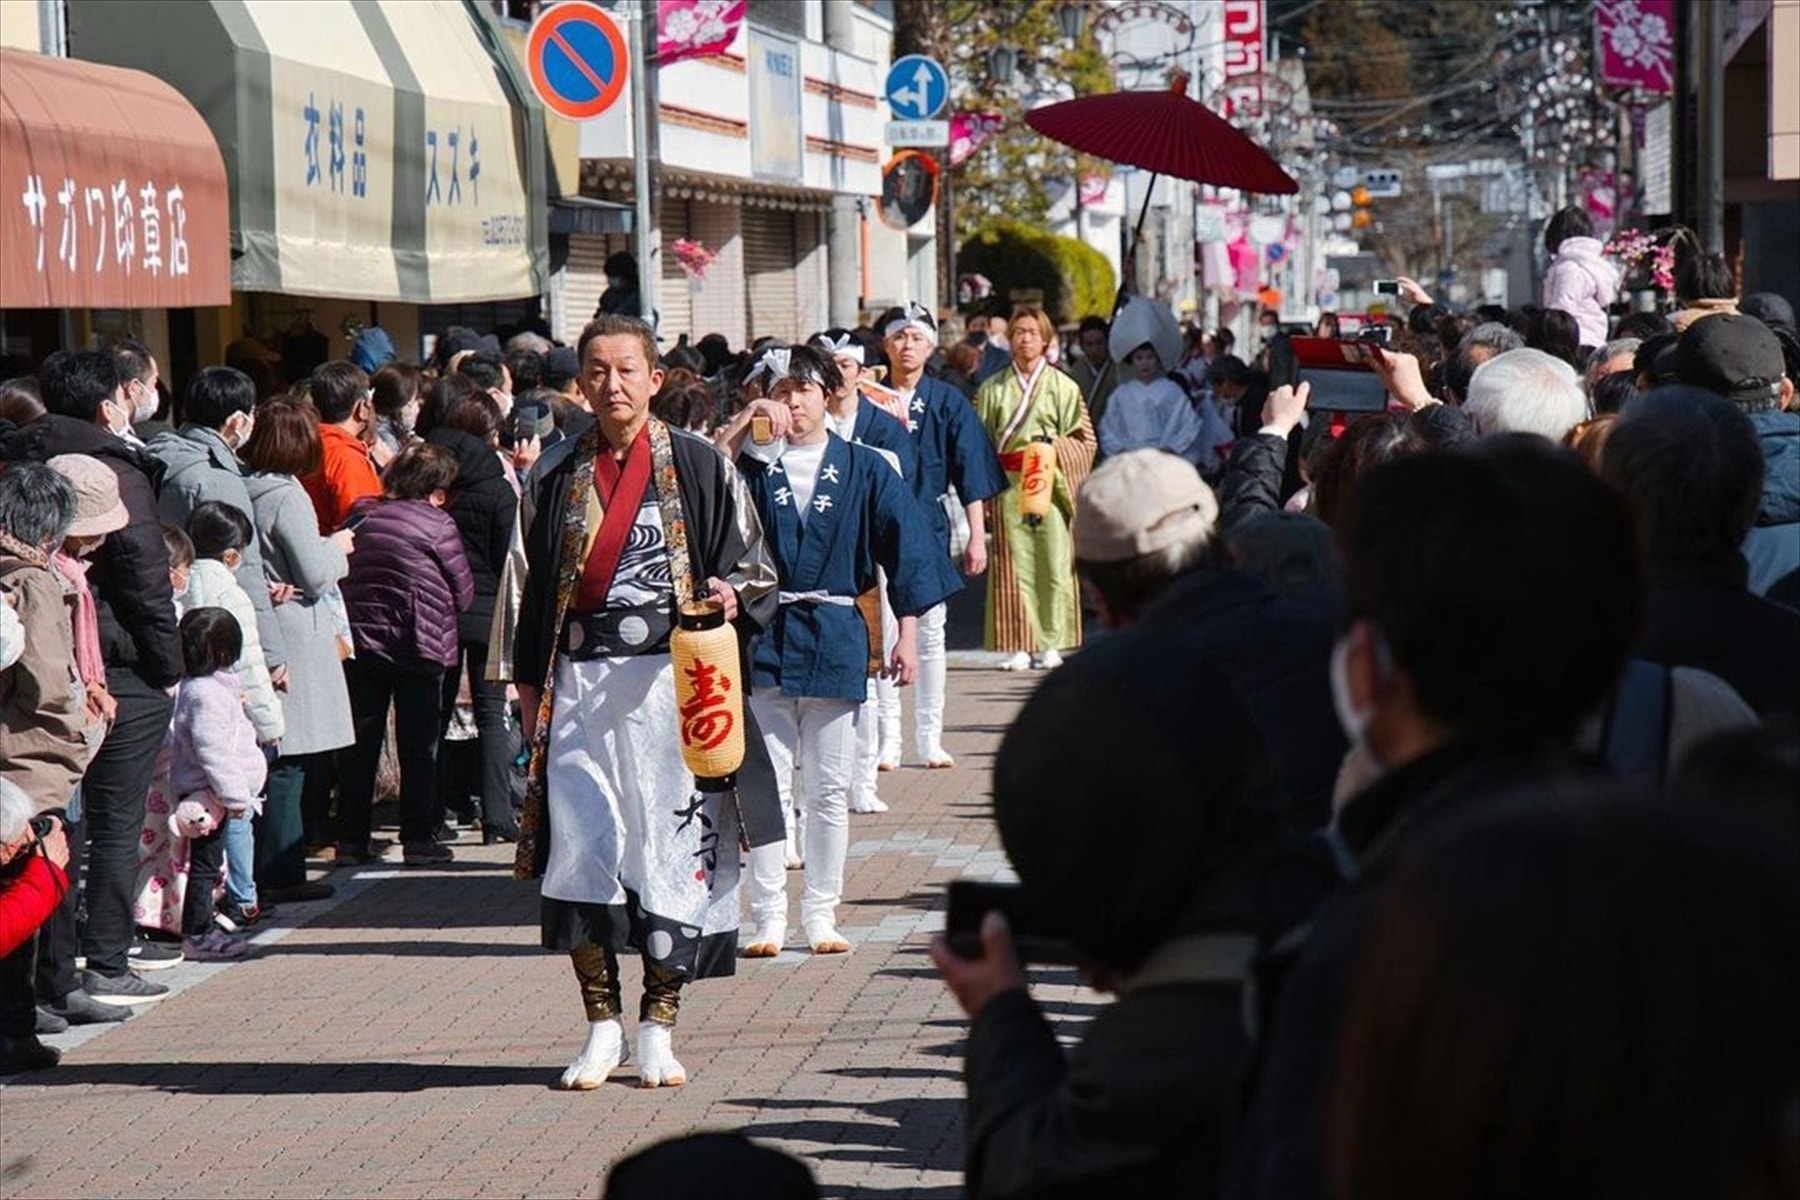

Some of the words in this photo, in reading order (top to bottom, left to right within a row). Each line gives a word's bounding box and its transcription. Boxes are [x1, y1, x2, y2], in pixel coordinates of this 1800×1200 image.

[304, 91, 366, 198] 衣料品
[426, 123, 480, 208] スズキ
[22, 174, 189, 278] サガワ印章店
[813, 463, 840, 514] 大子
